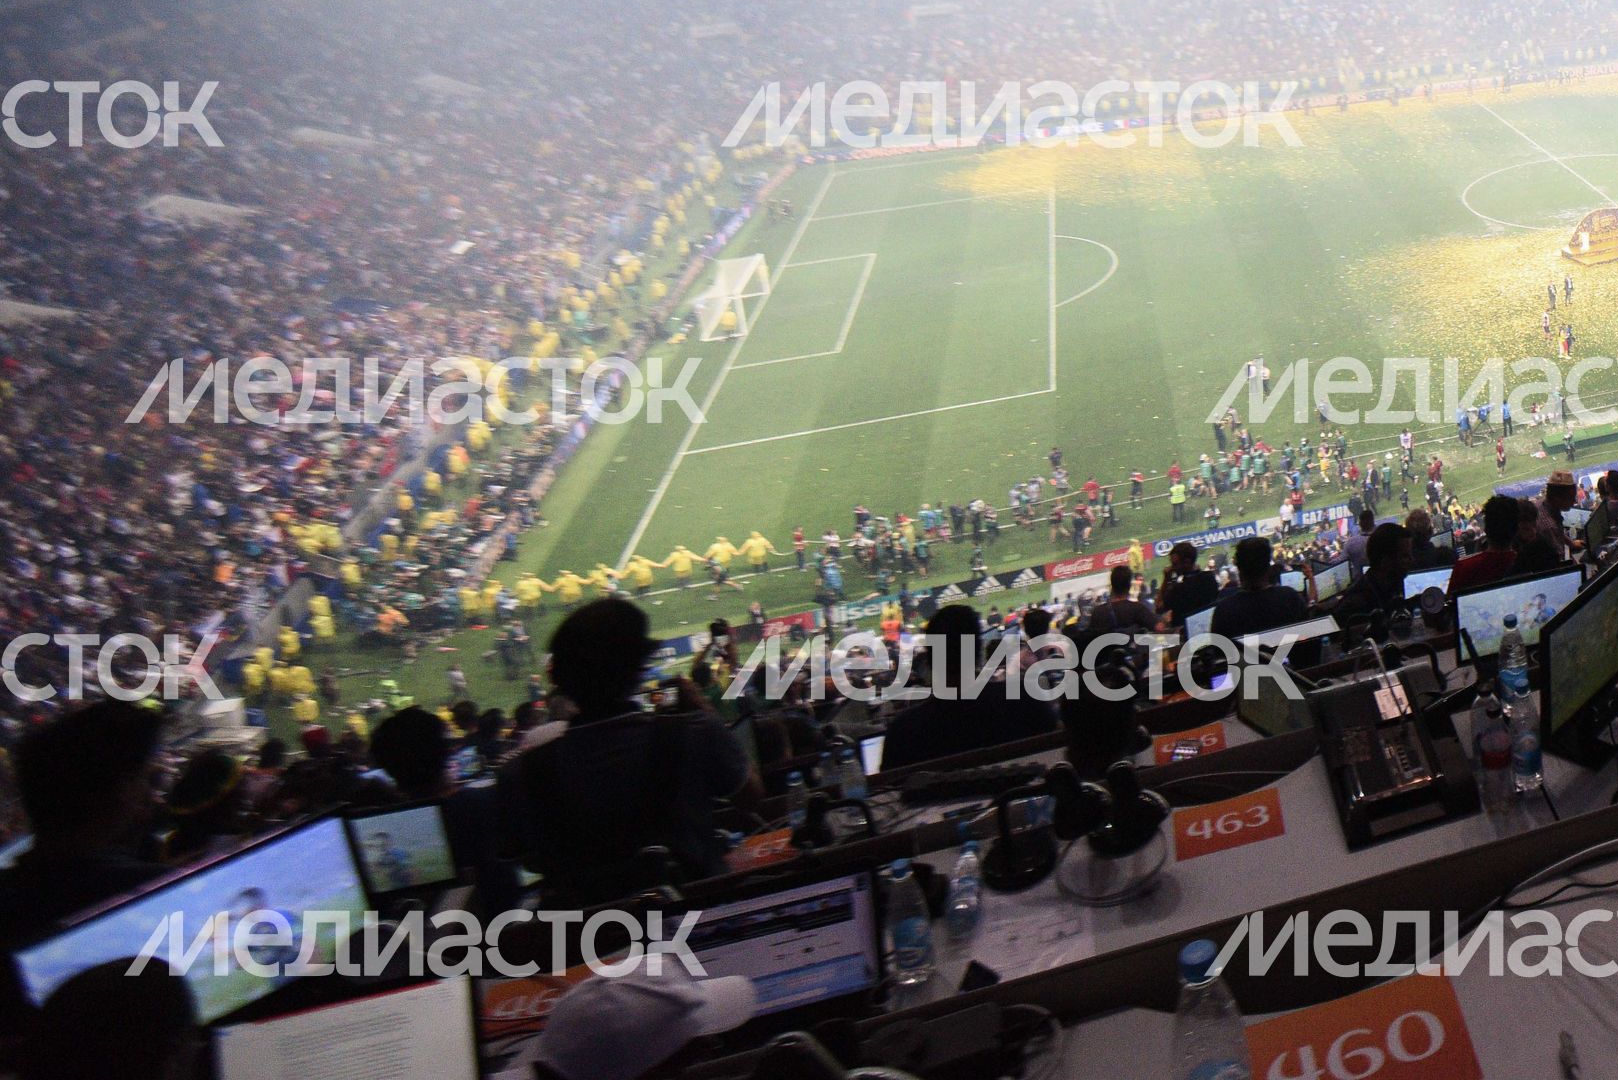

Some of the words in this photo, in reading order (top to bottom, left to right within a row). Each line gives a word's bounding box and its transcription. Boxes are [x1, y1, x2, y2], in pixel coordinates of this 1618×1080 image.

[1302, 504, 1354, 526] GAZROM
[1204, 525, 1256, 545] WANDA
[1185, 804, 1270, 840] 463
[493, 987, 560, 1018] 46
[1265, 1010, 1446, 1080] 460
